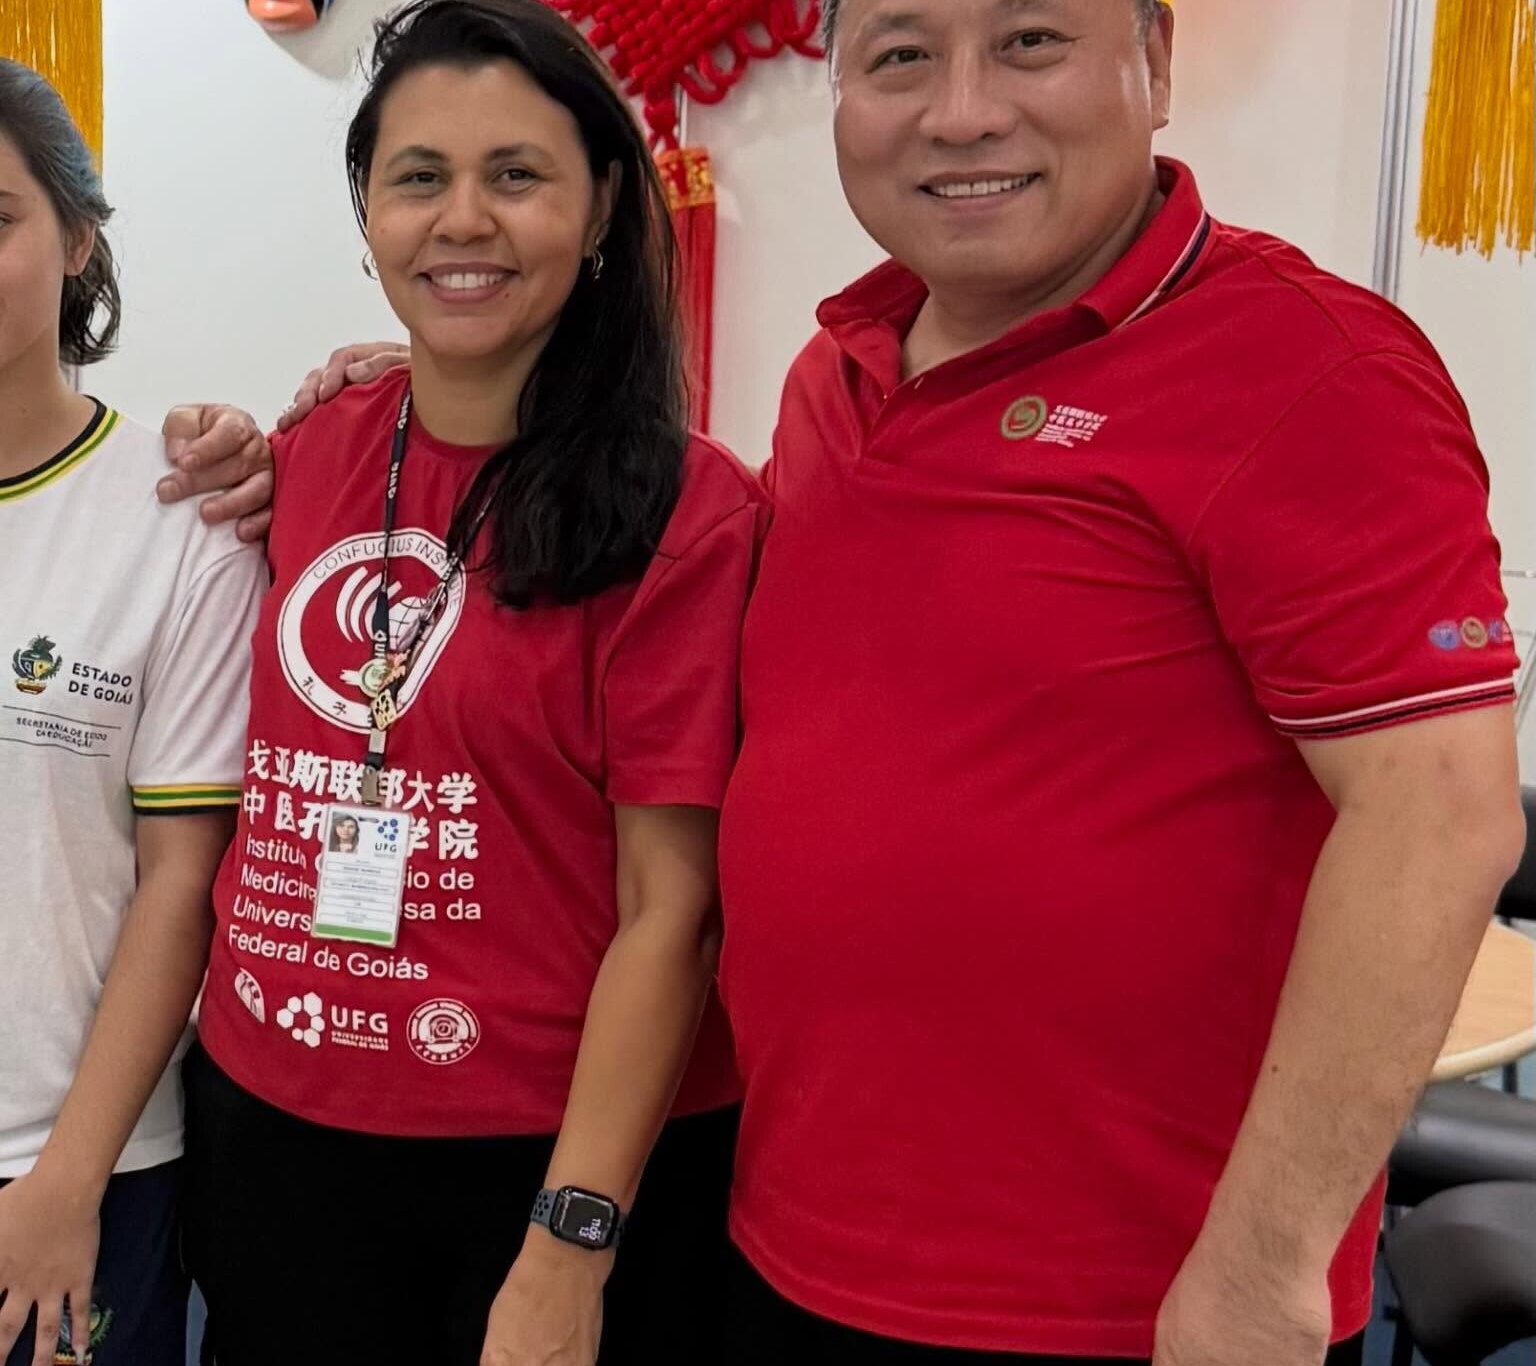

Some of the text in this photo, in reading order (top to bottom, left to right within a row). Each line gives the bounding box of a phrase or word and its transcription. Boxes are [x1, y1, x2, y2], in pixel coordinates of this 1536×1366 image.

[72, 662, 132, 687] ESTADO
[68, 681, 89, 696] DE
[439, 867, 475, 890] de
[233, 894, 311, 932] Univers
[446, 897, 482, 920] da
[228, 925, 429, 980] Federal de Goiás
[331, 1004, 389, 1035] UFG
